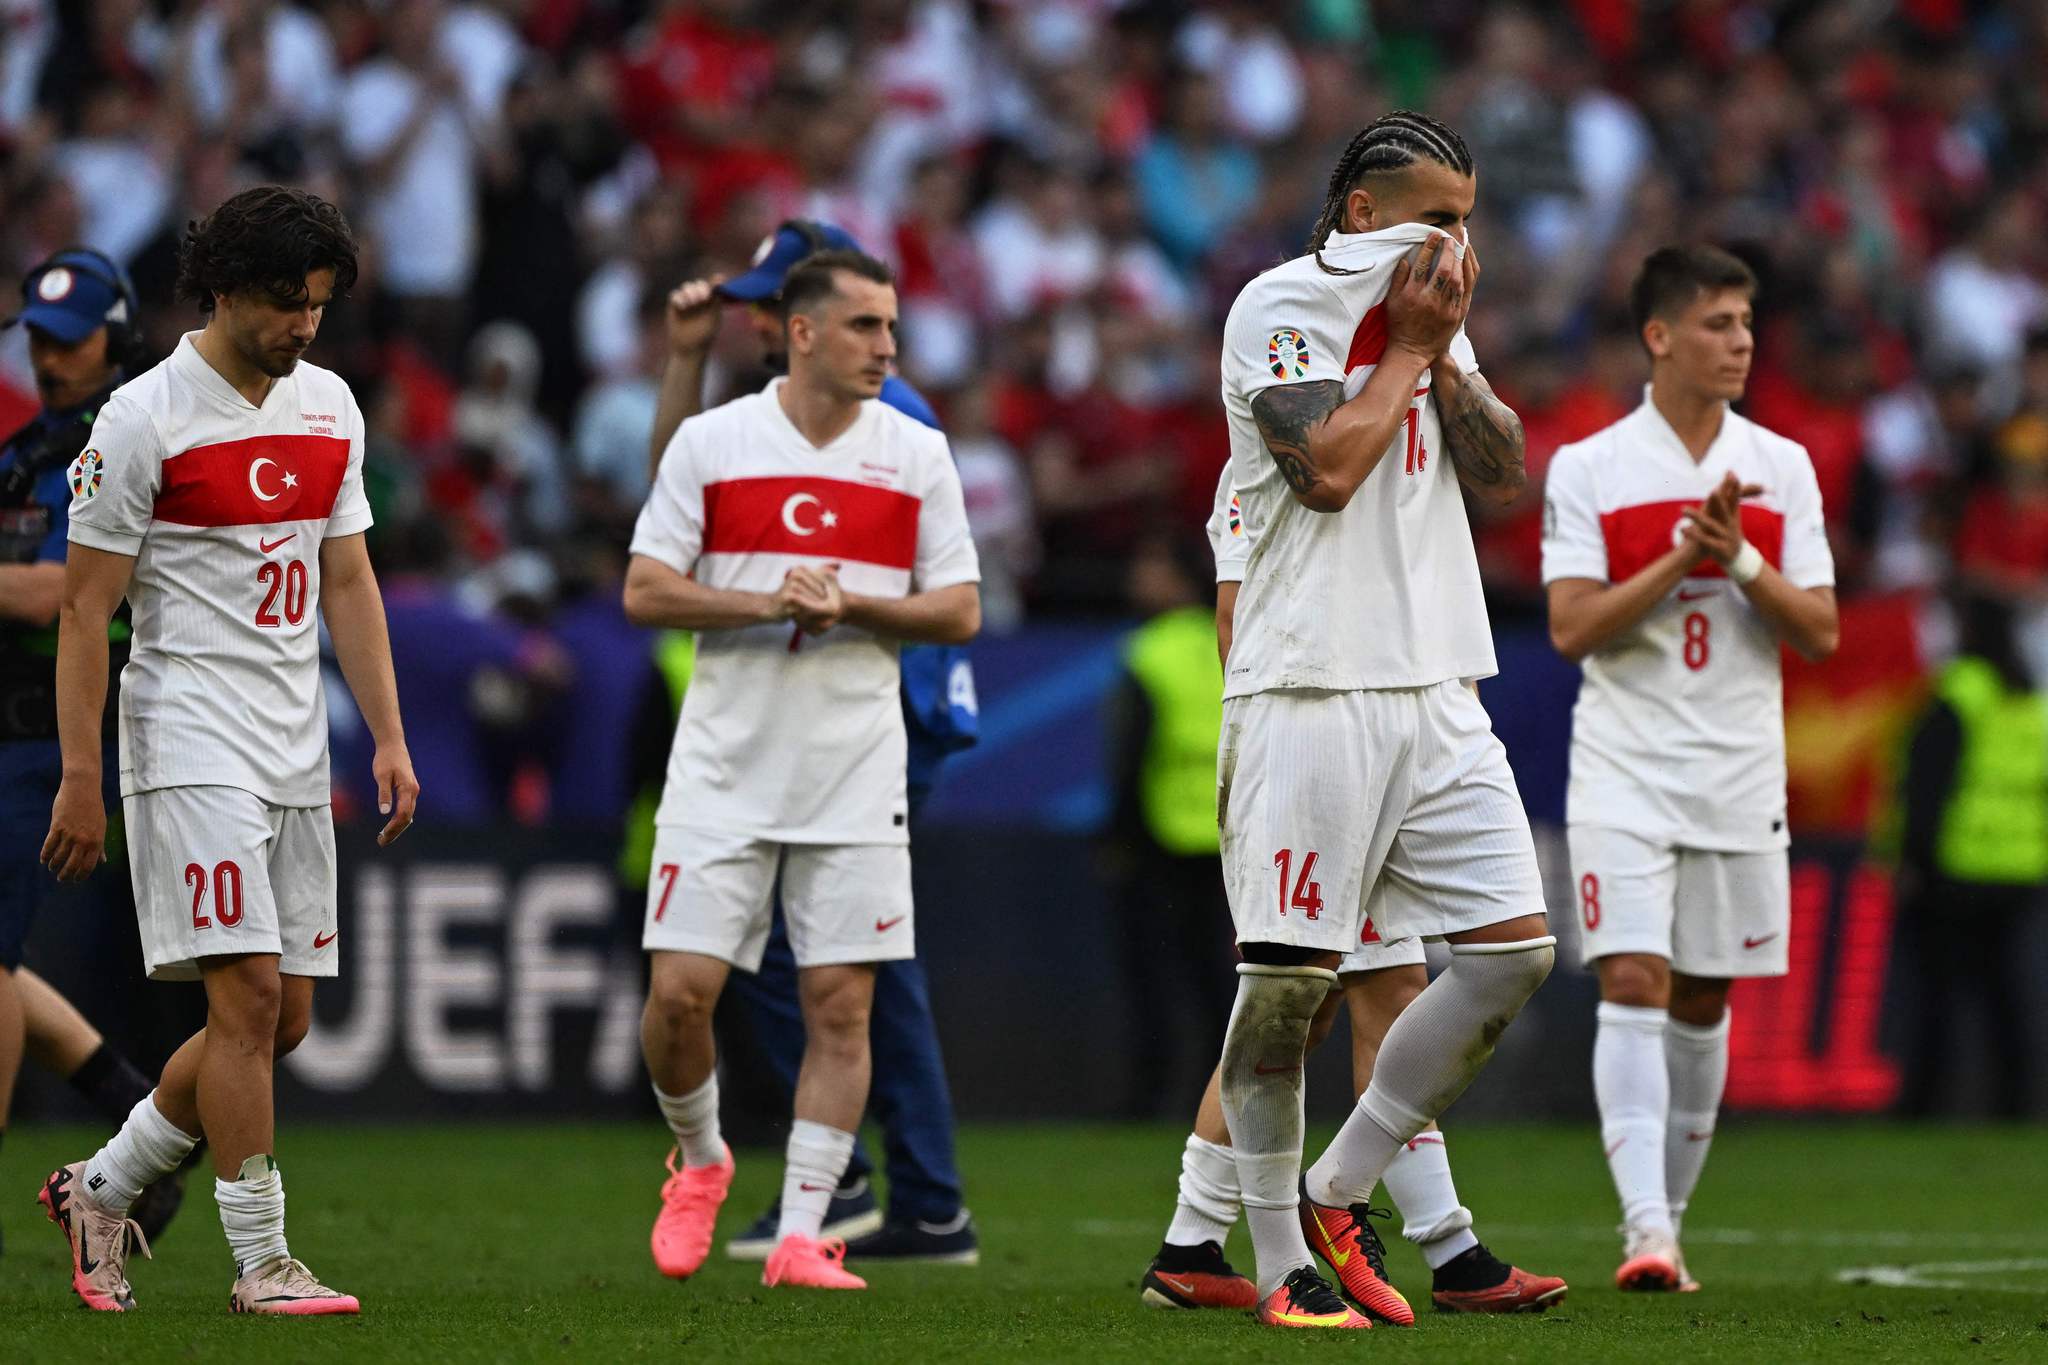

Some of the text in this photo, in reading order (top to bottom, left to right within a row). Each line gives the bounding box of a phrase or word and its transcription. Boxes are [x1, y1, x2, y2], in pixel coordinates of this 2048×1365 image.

[254, 559, 311, 628] 20
[1682, 611, 1710, 673] 8
[184, 859, 244, 928] 20
[655, 862, 682, 923] 7
[1273, 847, 1325, 920] 14
[1581, 872, 1601, 931] 8
